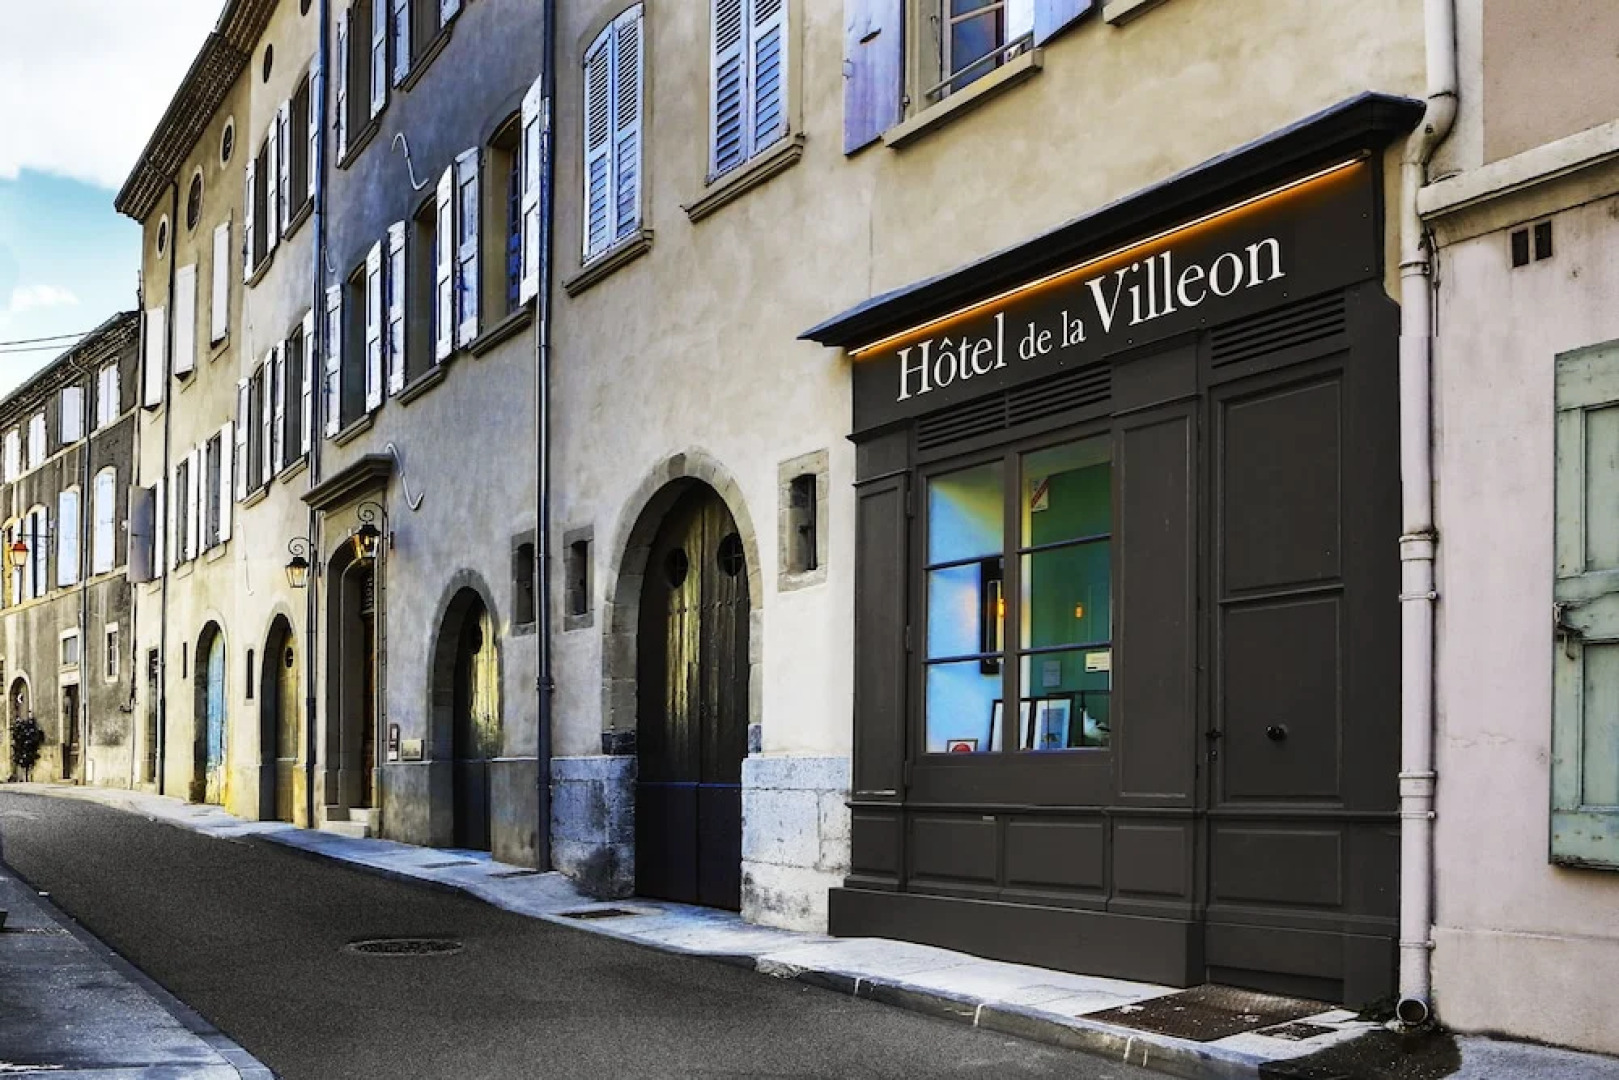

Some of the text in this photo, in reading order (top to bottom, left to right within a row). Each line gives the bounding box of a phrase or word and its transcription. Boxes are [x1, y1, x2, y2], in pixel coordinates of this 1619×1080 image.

[896, 237, 1286, 403] Hôtel de la Villeon
